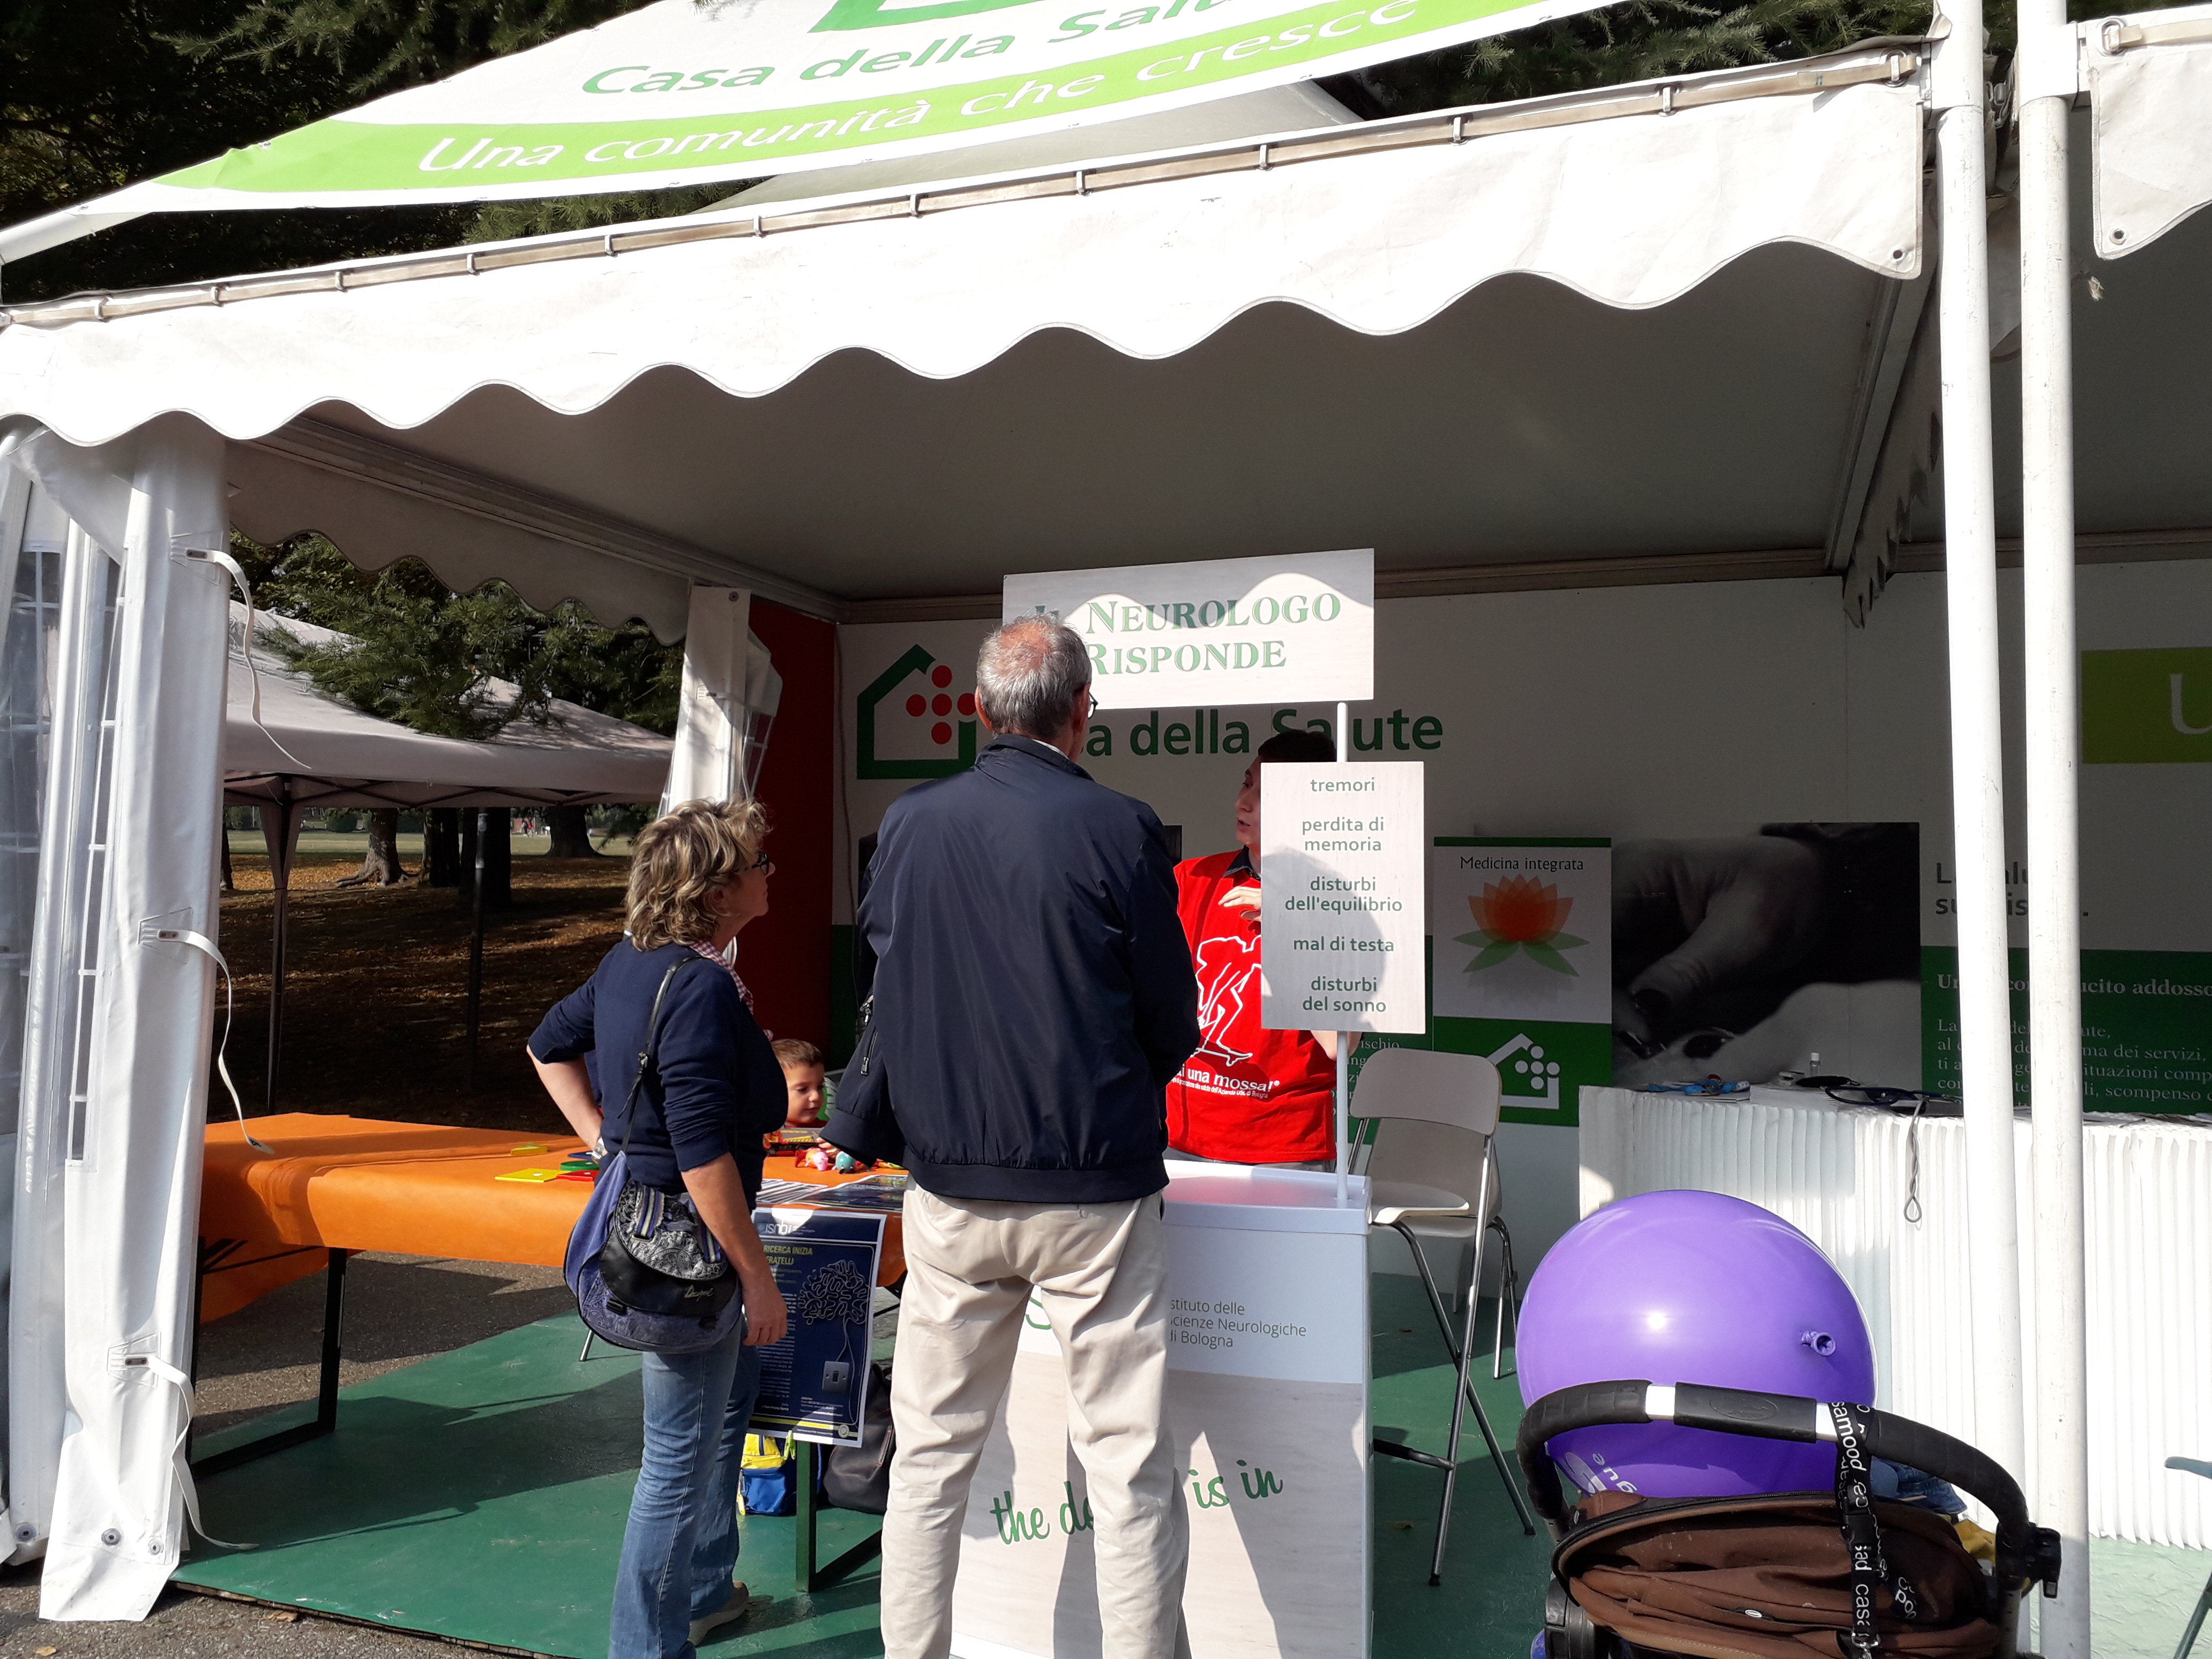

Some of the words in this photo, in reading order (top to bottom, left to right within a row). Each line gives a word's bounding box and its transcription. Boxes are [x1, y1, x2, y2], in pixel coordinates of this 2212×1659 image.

[582, 65, 775, 94] Casa
[799, 35, 1015, 80] della
[419, 138, 565, 172] Una
[584, 99, 932, 163] comunità
[960, 73, 1105, 117] che
[1135, 1, 1417, 81] cresce
[1085, 592, 1341, 634] NEUROLOGO
[1087, 640, 1287, 675] RISPONDE
[1129, 708, 1251, 755] della
[1310, 776, 1376, 792] tremori
[1302, 816, 1363, 836] perdita
[1369, 816, 1384, 831] di
[1304, 836, 1382, 851] memoria
[1460, 856, 1519, 870] Medicina
[1525, 857, 1584, 873] integrata
[1310, 876, 1377, 891] disturbi
[1285, 895, 1403, 915] dell'equilibrio
[1293, 936, 1325, 951] mal
[1329, 936, 1346, 951] di
[1349, 938, 1395, 952] testa
[1310, 975, 1377, 992] disturbi
[1302, 996, 1328, 1011] del
[1333, 1000, 1387, 1013] sonno
[1361, 1037, 1400, 1049] ischio
[1937, 1037, 1951, 1051] al
[2113, 1044, 2140, 1058] dei
[2144, 1047, 2206, 1062] servizi,
[1187, 1068, 1210, 1083] una
[1937, 1057, 1948, 1070] ti
[2083, 1063, 2158, 1079] ituazioni
[2105, 1087, 2201, 1102] scompenso
[1170, 1298, 1210, 1313] stituto
[1214, 1301, 1245, 1316] delle
[1170, 1314, 1214, 1329] cienze
[1218, 1318, 1307, 1338] Neurologiche
[1180, 1331, 1234, 1350] Bologna
[989, 1490, 1050, 1545] the
[1187, 1469, 1230, 1509] is
[1236, 1459, 1284, 1499] in
